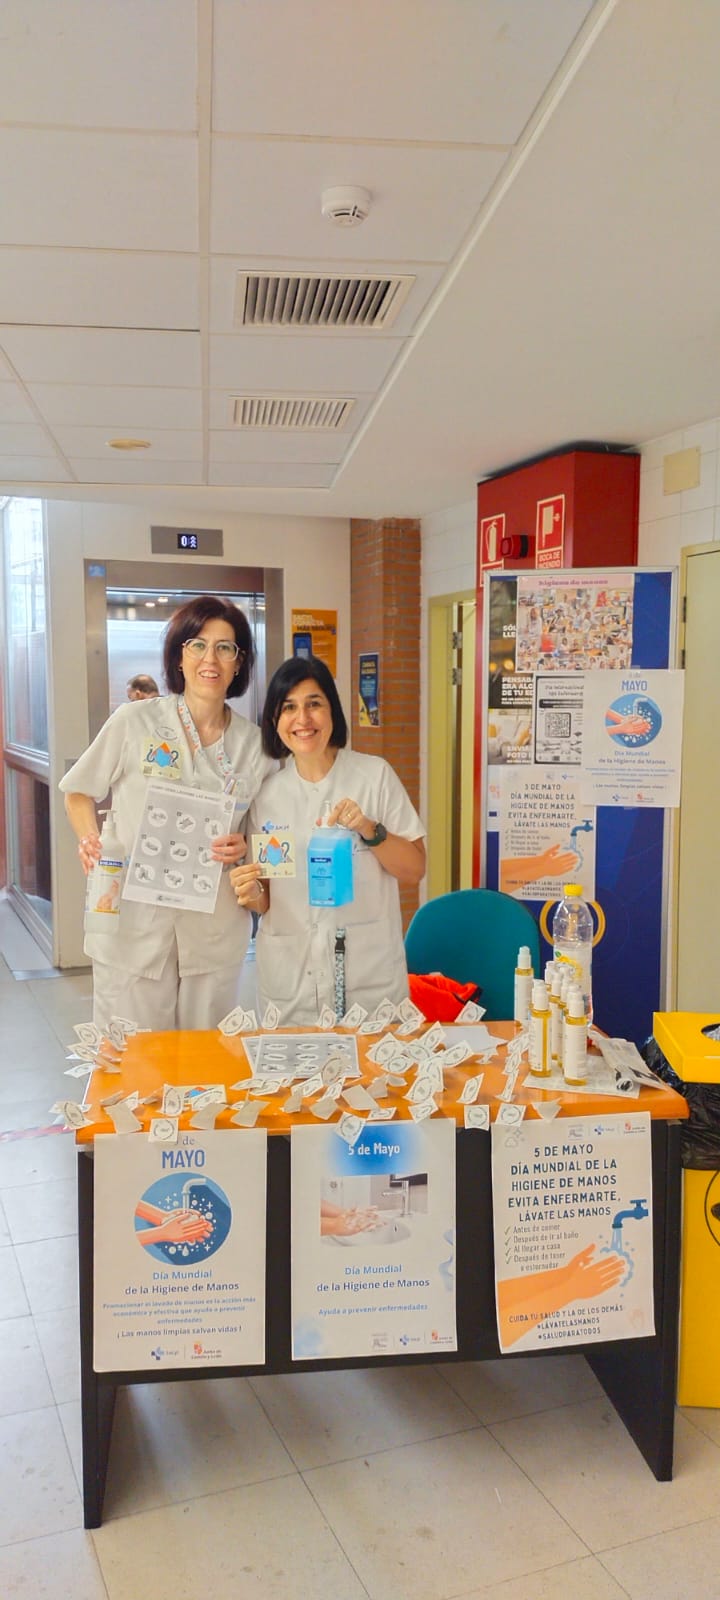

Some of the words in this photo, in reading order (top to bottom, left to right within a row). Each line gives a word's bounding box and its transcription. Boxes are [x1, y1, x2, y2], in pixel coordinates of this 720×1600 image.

[538, 552, 552, 562] BOCA
[553, 550, 560, 559] DE
[622, 680, 648, 692] MAYO
[510, 792, 522, 800] DÍA
[182, 1136, 195, 1145] de
[348, 1144, 354, 1156] 5
[358, 1144, 370, 1155] de
[374, 1142, 400, 1158] Mayo
[534, 1147, 540, 1158] 5
[544, 1146, 558, 1157] DE
[562, 1144, 594, 1156] MAYO
[162, 1150, 205, 1168] MAYO
[510, 1162, 530, 1176] DÍA
[533, 1161, 582, 1174] MUNDIAL
[586, 1160, 600, 1170] DE
[604, 1158, 618, 1170] LA
[512, 1178, 556, 1192] HIGIENE
[560, 1177, 574, 1188] DE
[578, 1174, 617, 1186] MANOS
[508, 1196, 540, 1208] EVITA
[543, 1190, 621, 1206] ENFERMARTE,
[520, 1210, 554, 1222] LÁVATE
[558, 1208, 575, 1218] LAS
[578, 1206, 612, 1218] MANOS
[514, 1234, 539, 1244] Después
[564, 1232, 579, 1240] baño
[522, 1244, 540, 1253] llegar
[514, 1254, 540, 1263] Después
[152, 1272, 168, 1280] Día
[172, 1270, 212, 1280] Mundial
[344, 1266, 360, 1275] Día
[363, 1264, 402, 1274] Mundial
[125, 1286, 138, 1295] de
[140, 1285, 149, 1294] la
[152, 1284, 190, 1296] Higiene
[192, 1283, 204, 1292] de
[206, 1282, 240, 1292] Manos
[316, 1282, 329, 1292] de
[332, 1282, 340, 1291] la
[343, 1281, 380, 1292] Higiene
[382, 1280, 395, 1288] de
[397, 1278, 430, 1288] Manos
[318, 1307, 340, 1317] Ayuda
[348, 1306, 377, 1315] prevenir
[378, 1303, 428, 1312] enfermedades
[509, 1314, 528, 1323] CUIDA
[540, 1311, 560, 1320] SALUD
[578, 1308, 586, 1316] DE
[587, 1306, 600, 1315] LOS
[602, 1304, 624, 1314] DEMÁS
[136, 1328, 162, 1336] manos
[163, 1328, 190, 1337] limpias
[192, 1326, 216, 1334] salvan
[218, 1324, 238, 1333] vidas
